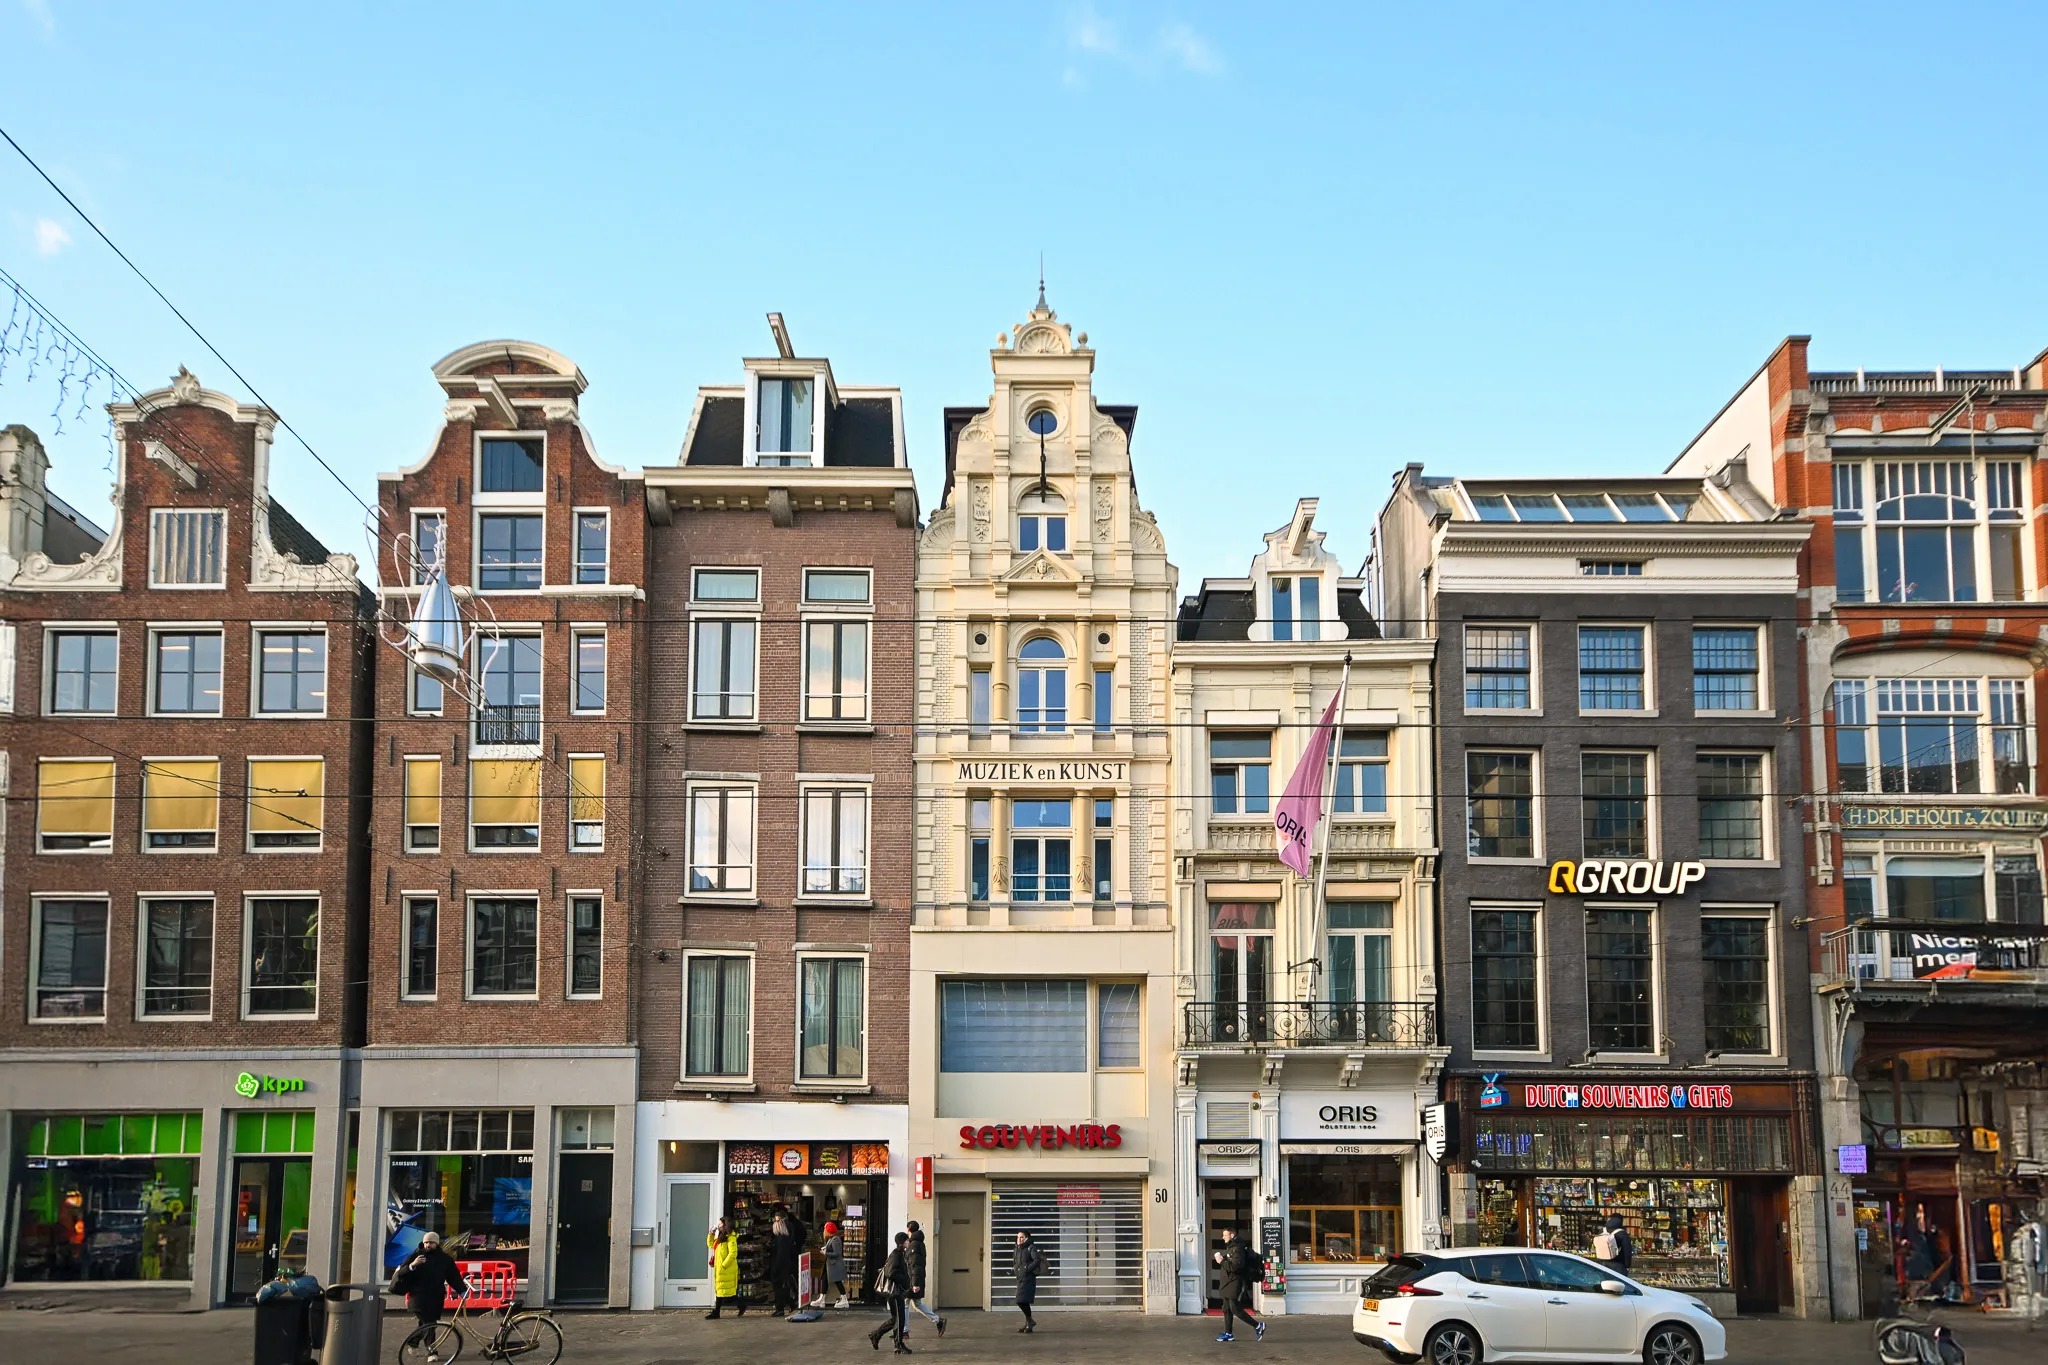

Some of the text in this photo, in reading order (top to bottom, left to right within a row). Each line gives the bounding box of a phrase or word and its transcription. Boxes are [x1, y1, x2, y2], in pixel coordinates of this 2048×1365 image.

[958, 763, 1127, 780] MUZIEK en KUNST
[1548, 860, 1706, 894] QGROUP
[263, 1074, 304, 1096] kpn
[1525, 1084, 1579, 1108] DUTCH
[1581, 1084, 1670, 1108] SOUVENIRS
[1688, 1084, 1733, 1108] GIFTS
[1319, 1105, 1377, 1122] ORIS
[959, 1124, 1122, 1149] SOUVENIRS
[1428, 1125, 1445, 1139] ORIS
[1217, 1145, 1243, 1154] ORIS
[1335, 1145, 1360, 1153] ORIS
[729, 1163, 769, 1174] COFFEE
[1155, 1188, 1168, 1203] 50
[1830, 1181, 1849, 1195] 44
